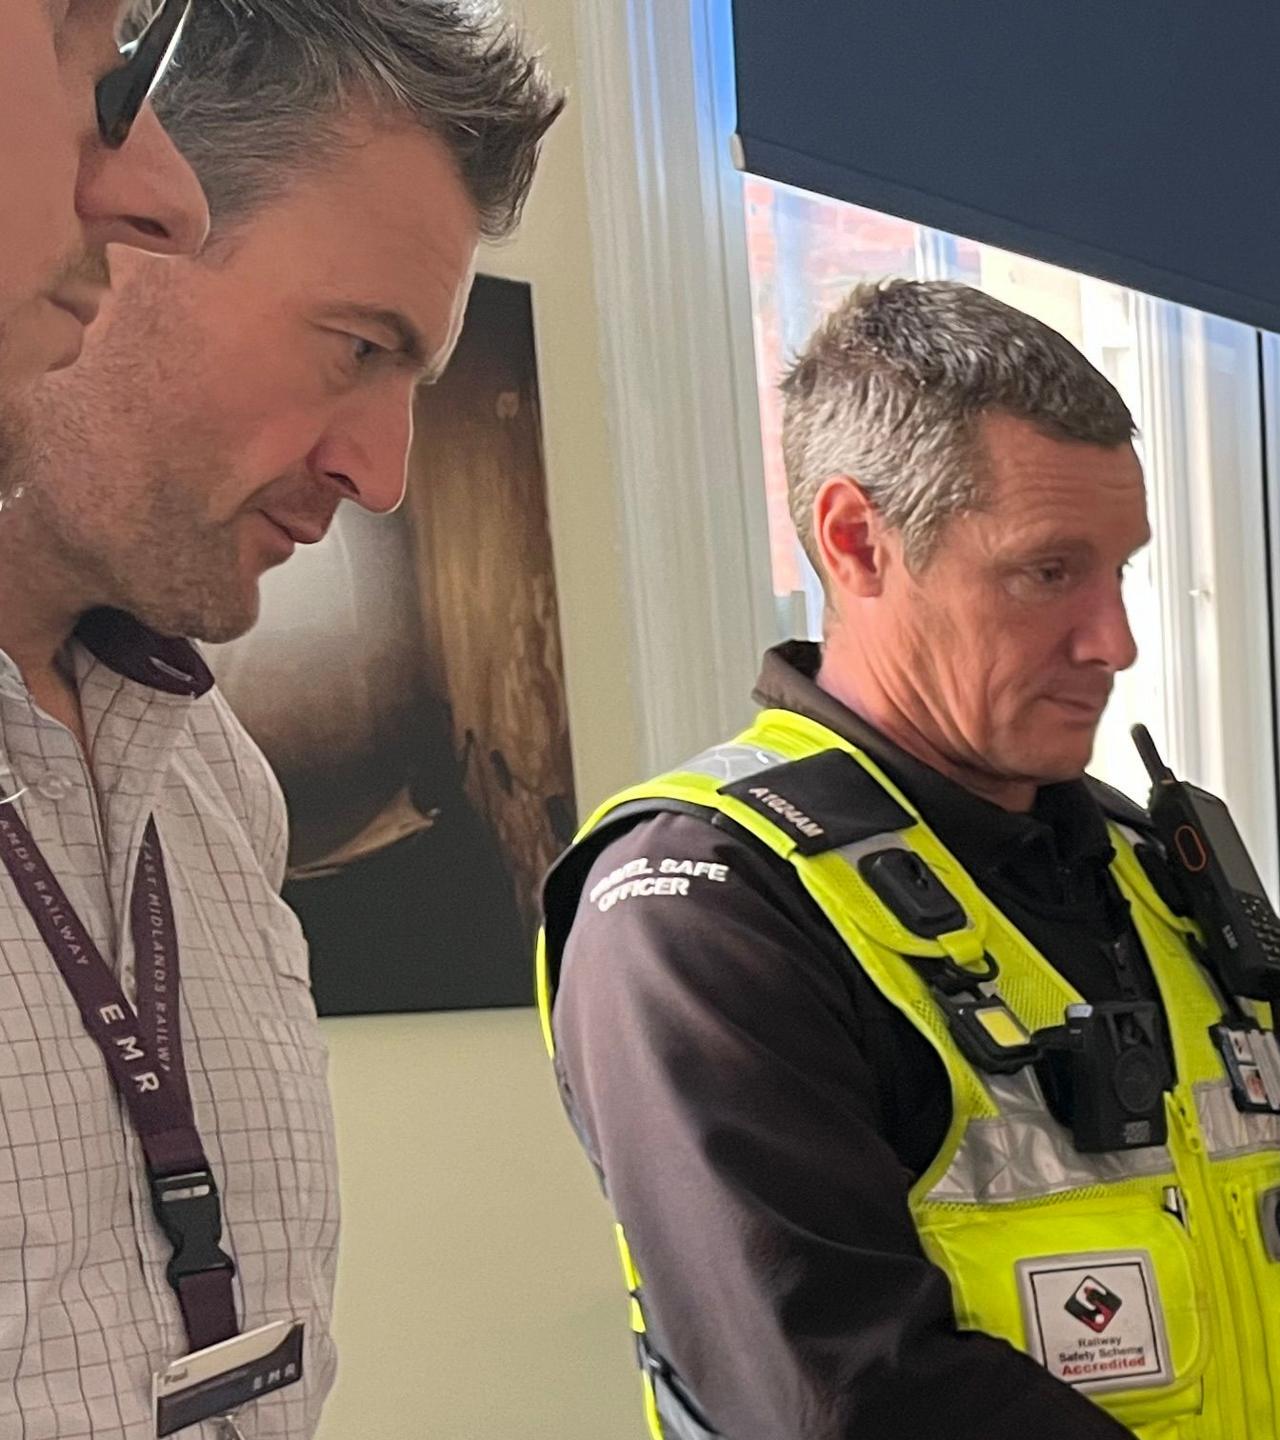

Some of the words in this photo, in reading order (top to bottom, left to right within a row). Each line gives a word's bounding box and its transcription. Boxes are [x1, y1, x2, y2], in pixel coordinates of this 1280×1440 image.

[658, 857, 730, 883] SAFE
[33, 880, 89, 966] RAILWAY
[148, 892, 167, 995] MIDLANDS
[99, 1003, 160, 1093] EMR
[1058, 1350, 1096, 1363] Safety
[1099, 1346, 1144, 1358] Scheme
[1078, 1335, 1122, 1348] Railway
[1061, 1356, 1146, 1377] Accredited
